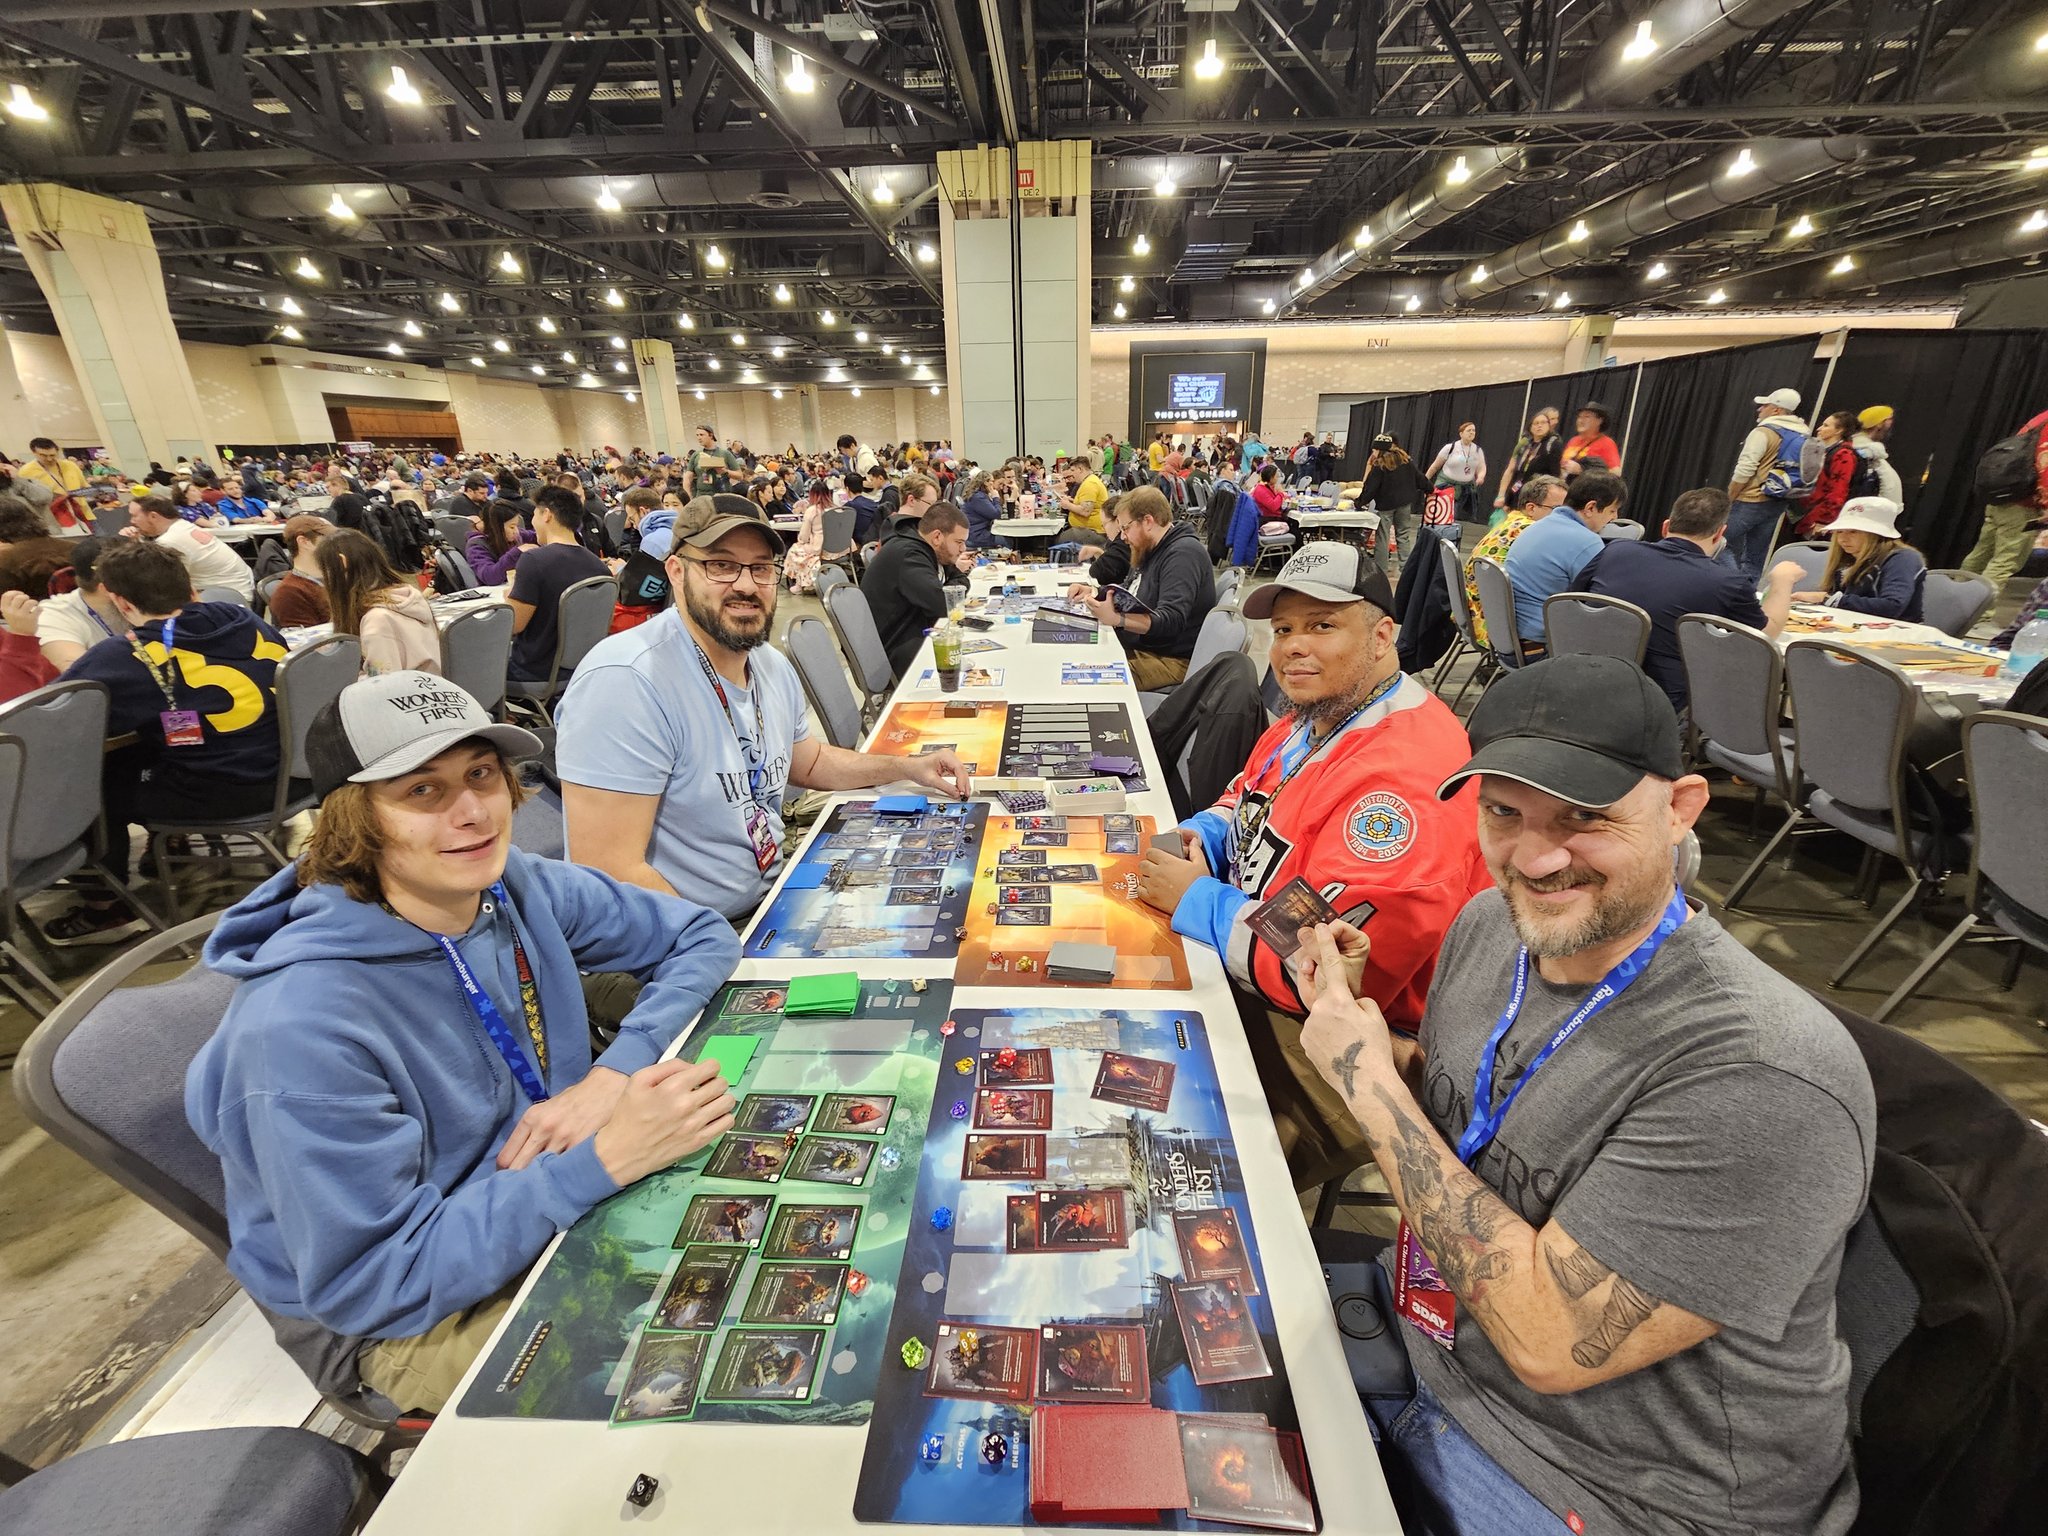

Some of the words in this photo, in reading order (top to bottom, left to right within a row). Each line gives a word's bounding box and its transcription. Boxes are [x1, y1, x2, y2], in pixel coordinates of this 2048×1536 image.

[1367, 338, 1391, 348] EXIT
[1052, 633, 1077, 642] IVION
[387, 691, 468, 711] WONDERS
[419, 707, 467, 725] FIRST
[1359, 793, 1407, 813] AUTOBOTS
[1349, 837, 1368, 856] 1984
[1377, 842, 1404, 859] 2024
[440, 936, 479, 996] Ravensburger
[1505, 944, 1529, 1021] Ravensburger
[1551, 984, 1615, 1050] Ravensburger
[1165, 1151, 1192, 1213] ONDERS
[1193, 1167, 1219, 1210] FIRST
[1401, 1243, 1409, 1268] Claus
[1399, 1268, 1408, 1292] Loves
[1398, 1292, 1406, 1307] Me
[1411, 1301, 1449, 1331] 3DAY
[518, 1320, 544, 1357] COLLECTORS
[502, 1356, 523, 1383] EDITION
[512, 1327, 550, 1384] EXISTENCE
[956, 1427, 968, 1470] ACTIONS
[1011, 1430, 1021, 1469] ENERGY
